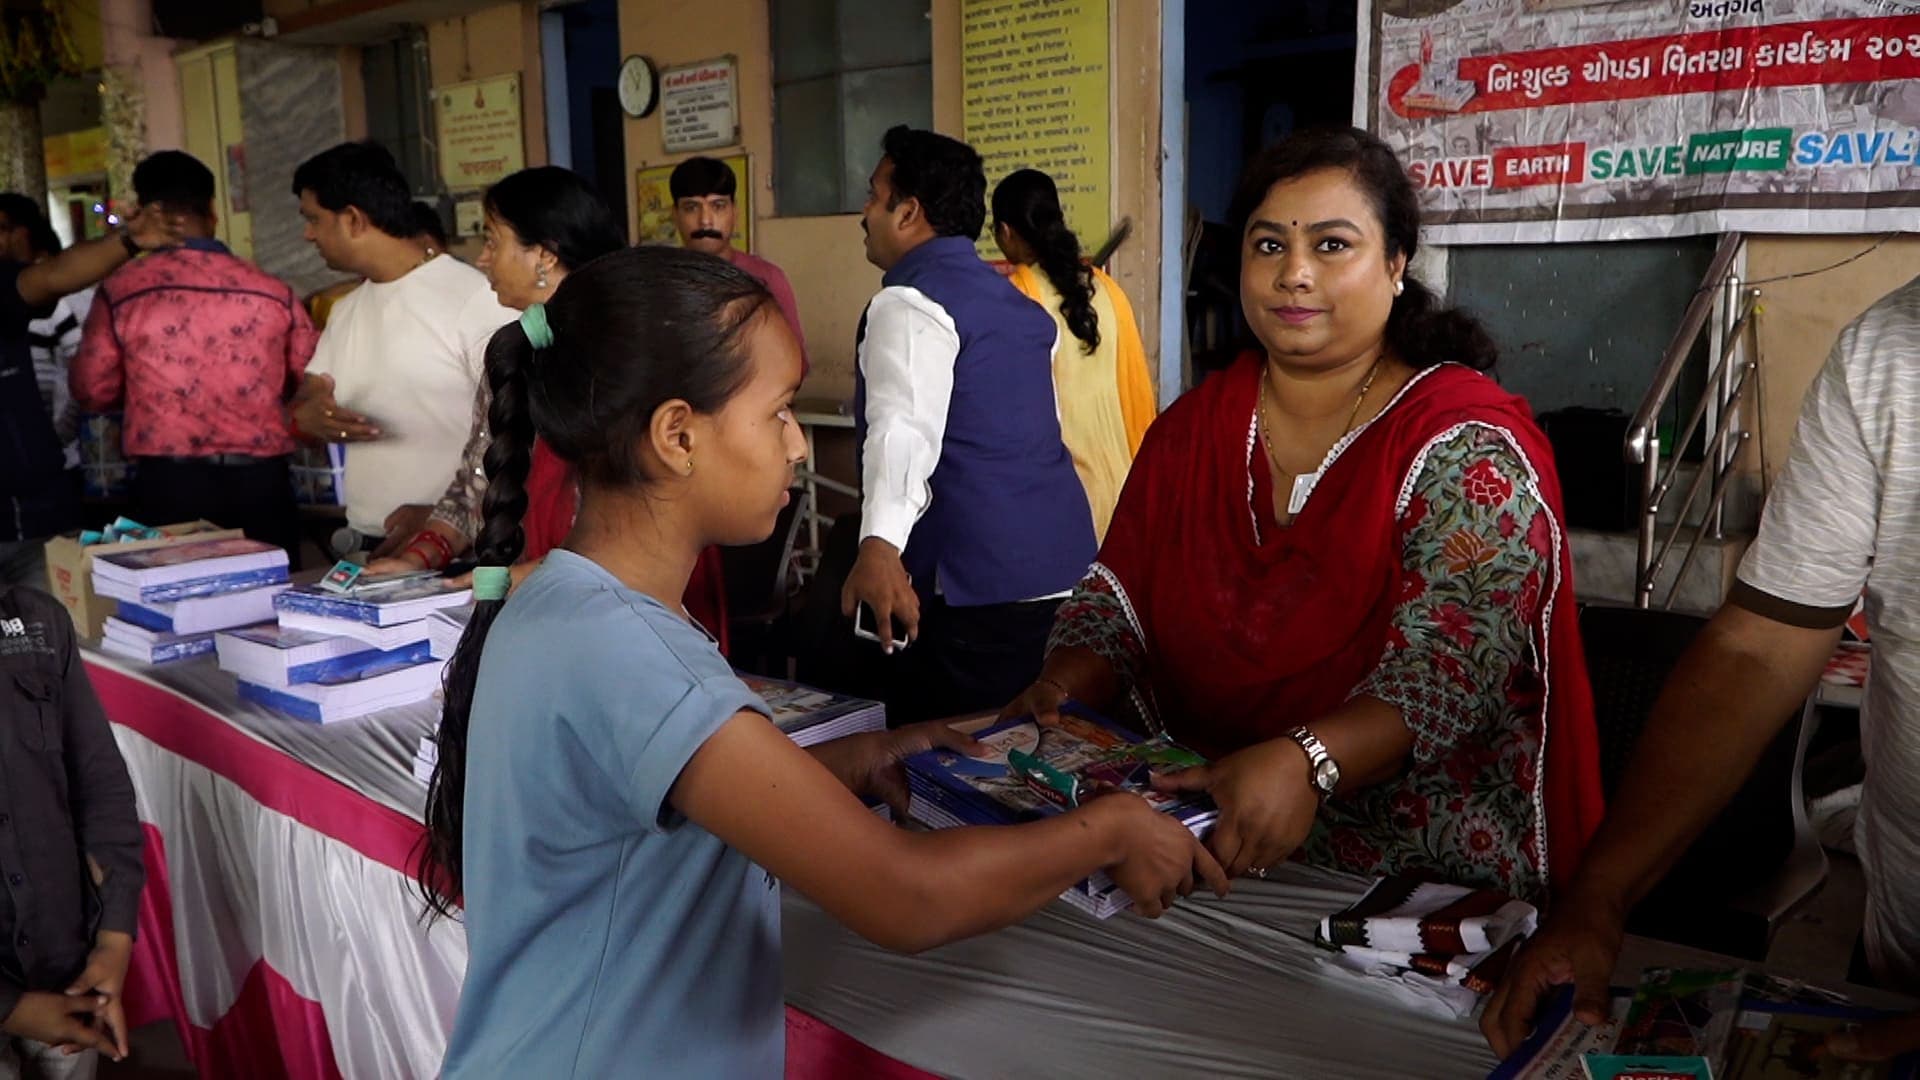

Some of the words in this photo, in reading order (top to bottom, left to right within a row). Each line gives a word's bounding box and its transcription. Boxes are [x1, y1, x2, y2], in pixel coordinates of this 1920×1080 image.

[1582, 51, 1650, 83] ચોપડા
[1661, 43, 1743, 76] વિતરણ
[1755, 30, 1851, 67] કાર્યક્રમ
[1407, 159, 1489, 190] SAVE
[1506, 154, 1570, 176] EARTH
[1590, 145, 1683, 180] SAVE
[1692, 140, 1782, 162] NATURE
